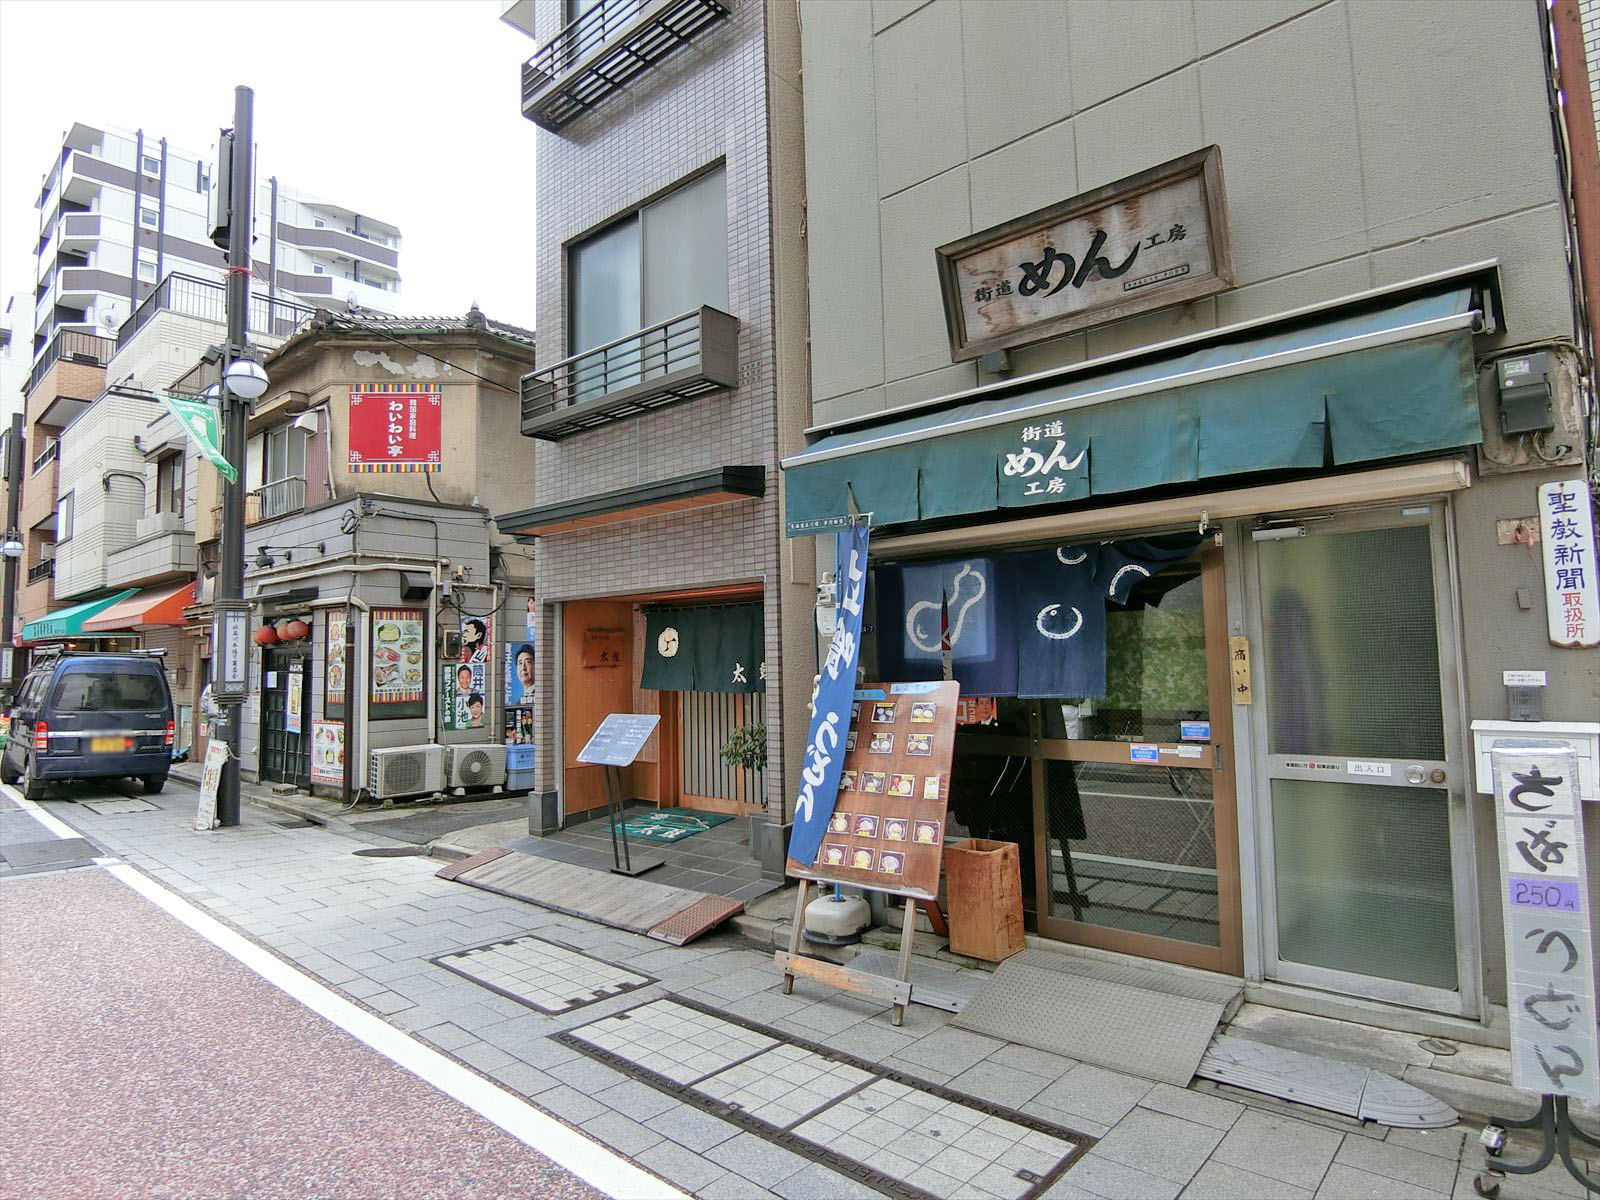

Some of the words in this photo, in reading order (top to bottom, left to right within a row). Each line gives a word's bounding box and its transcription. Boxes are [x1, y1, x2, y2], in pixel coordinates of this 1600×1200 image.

[974, 224, 1186, 303] 街道めん工房
[387, 400, 404, 457] わいわい亭
[1021, 420, 1065, 442] 街道
[1003, 440, 1085, 478] めん
[1024, 477, 1066, 496] 工房
[1234, 648, 1248, 694] 商い中
[794, 711, 840, 824] うどん
[1353, 763, 1386, 775] 出入口
[1524, 928, 1585, 1089] うどん
